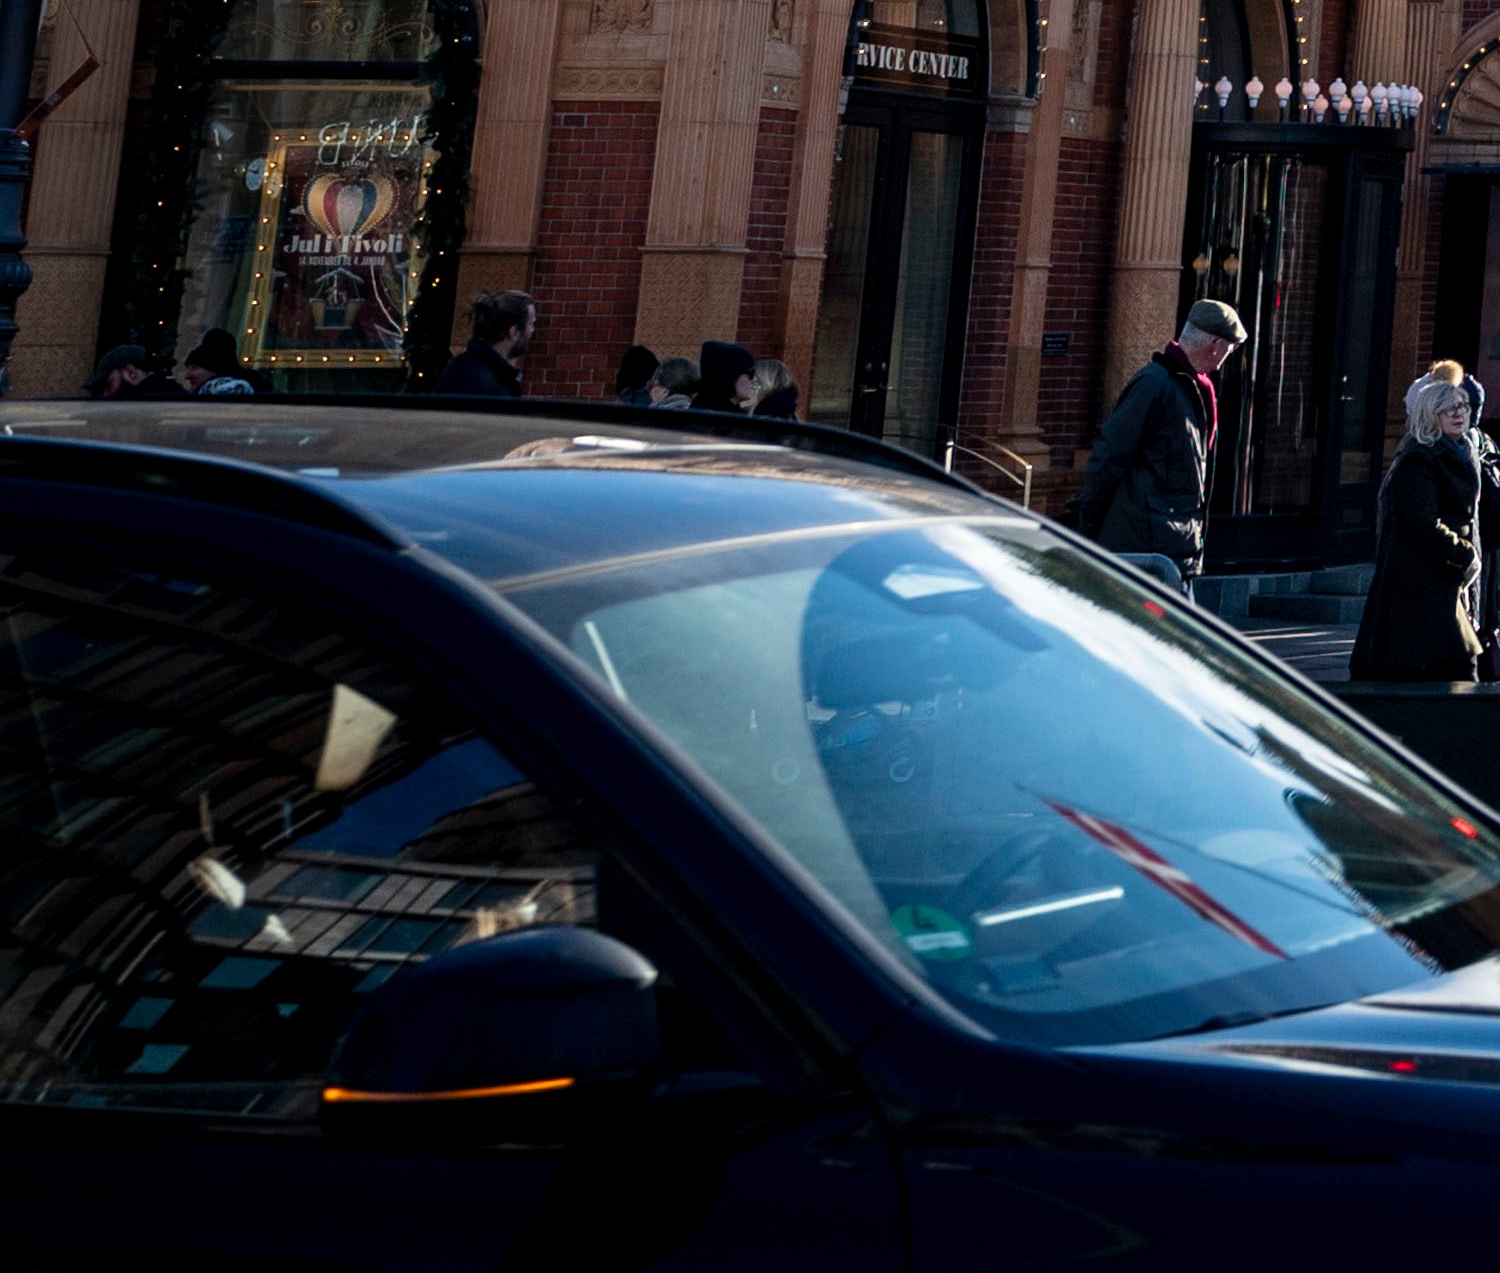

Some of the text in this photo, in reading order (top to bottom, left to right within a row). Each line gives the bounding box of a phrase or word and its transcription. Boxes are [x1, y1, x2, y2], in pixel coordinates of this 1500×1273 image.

[857, 42, 969, 80] RVICE CENTER
[283, 234, 403, 254] Jul i Tivoli
